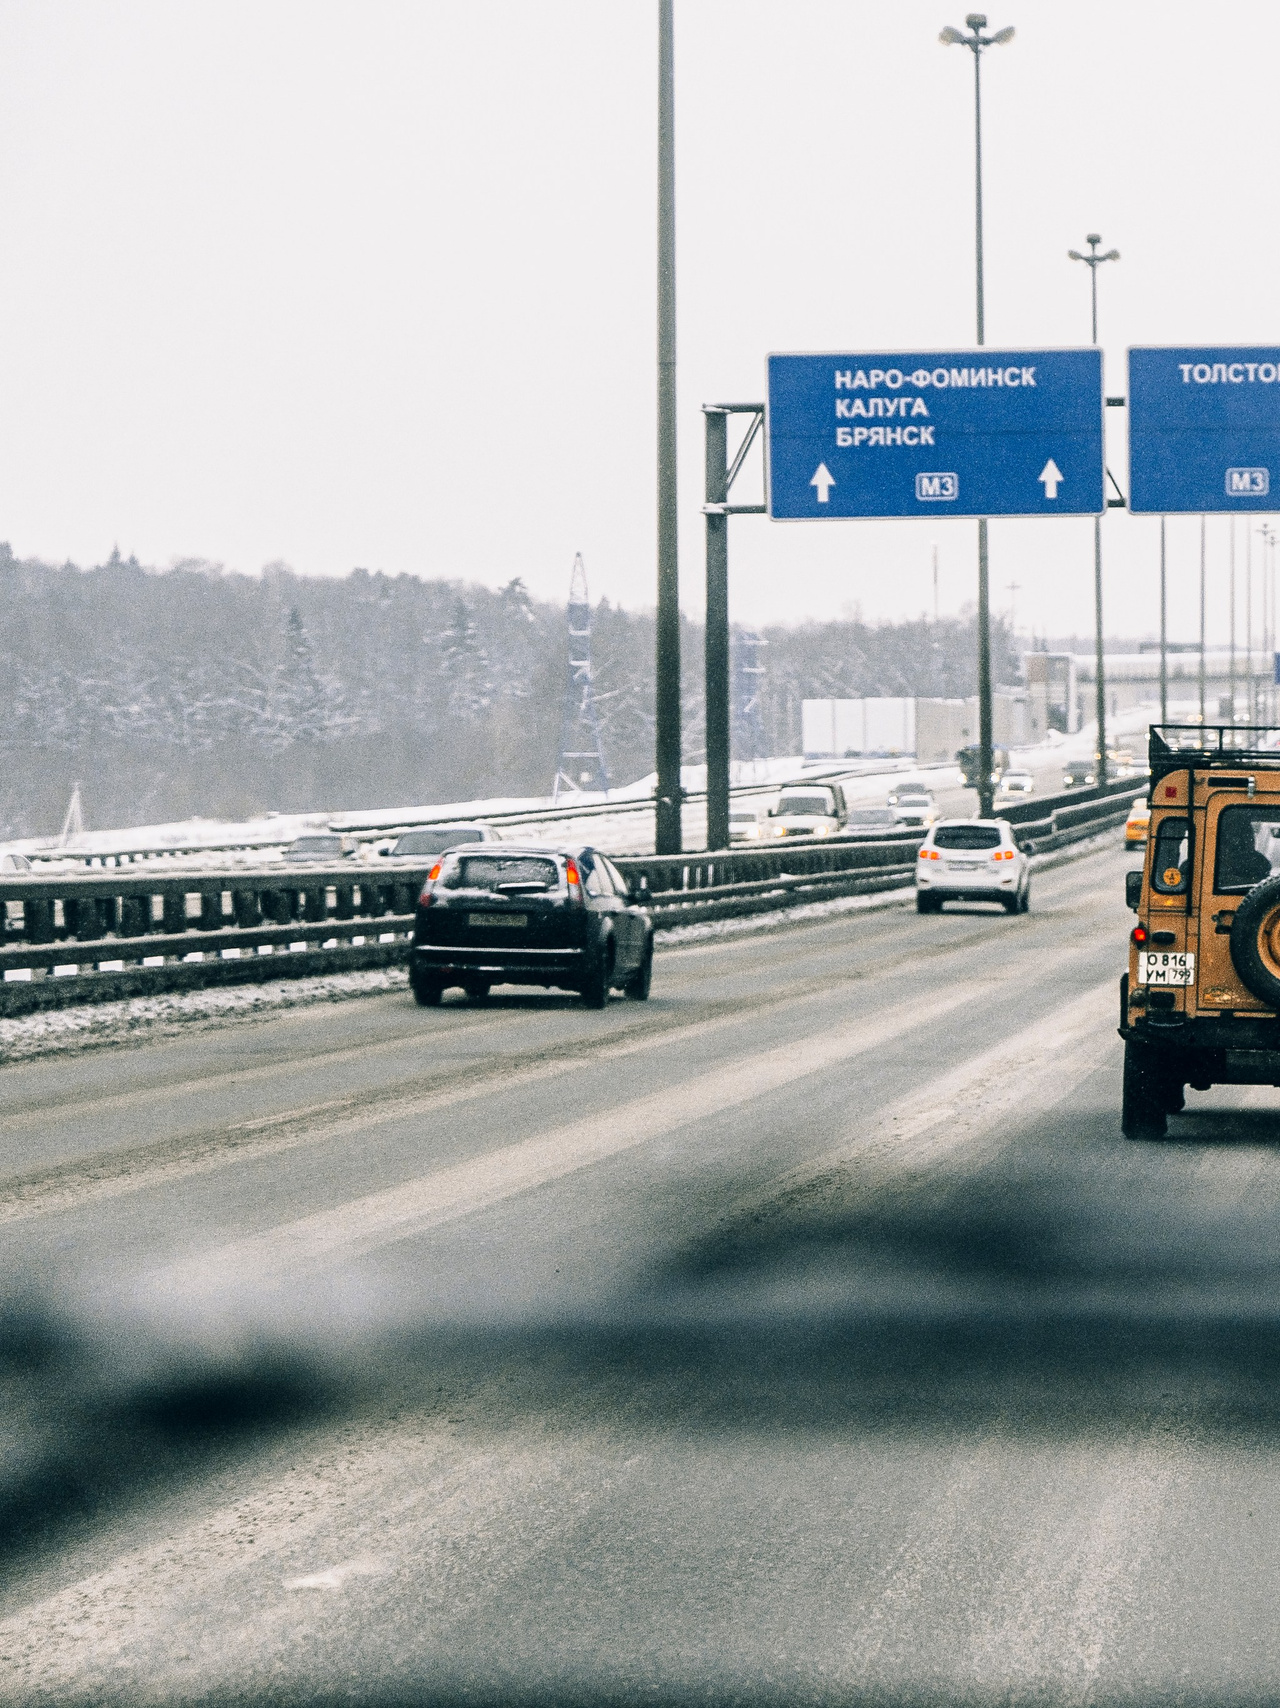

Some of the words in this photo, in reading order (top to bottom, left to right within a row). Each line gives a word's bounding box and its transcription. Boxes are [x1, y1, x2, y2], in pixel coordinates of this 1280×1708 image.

[835, 367, 1036, 389] НАРО-ФОМИНСК
[836, 397, 928, 418] КАЛУГА
[836, 426, 935, 447] БРЯНСК
